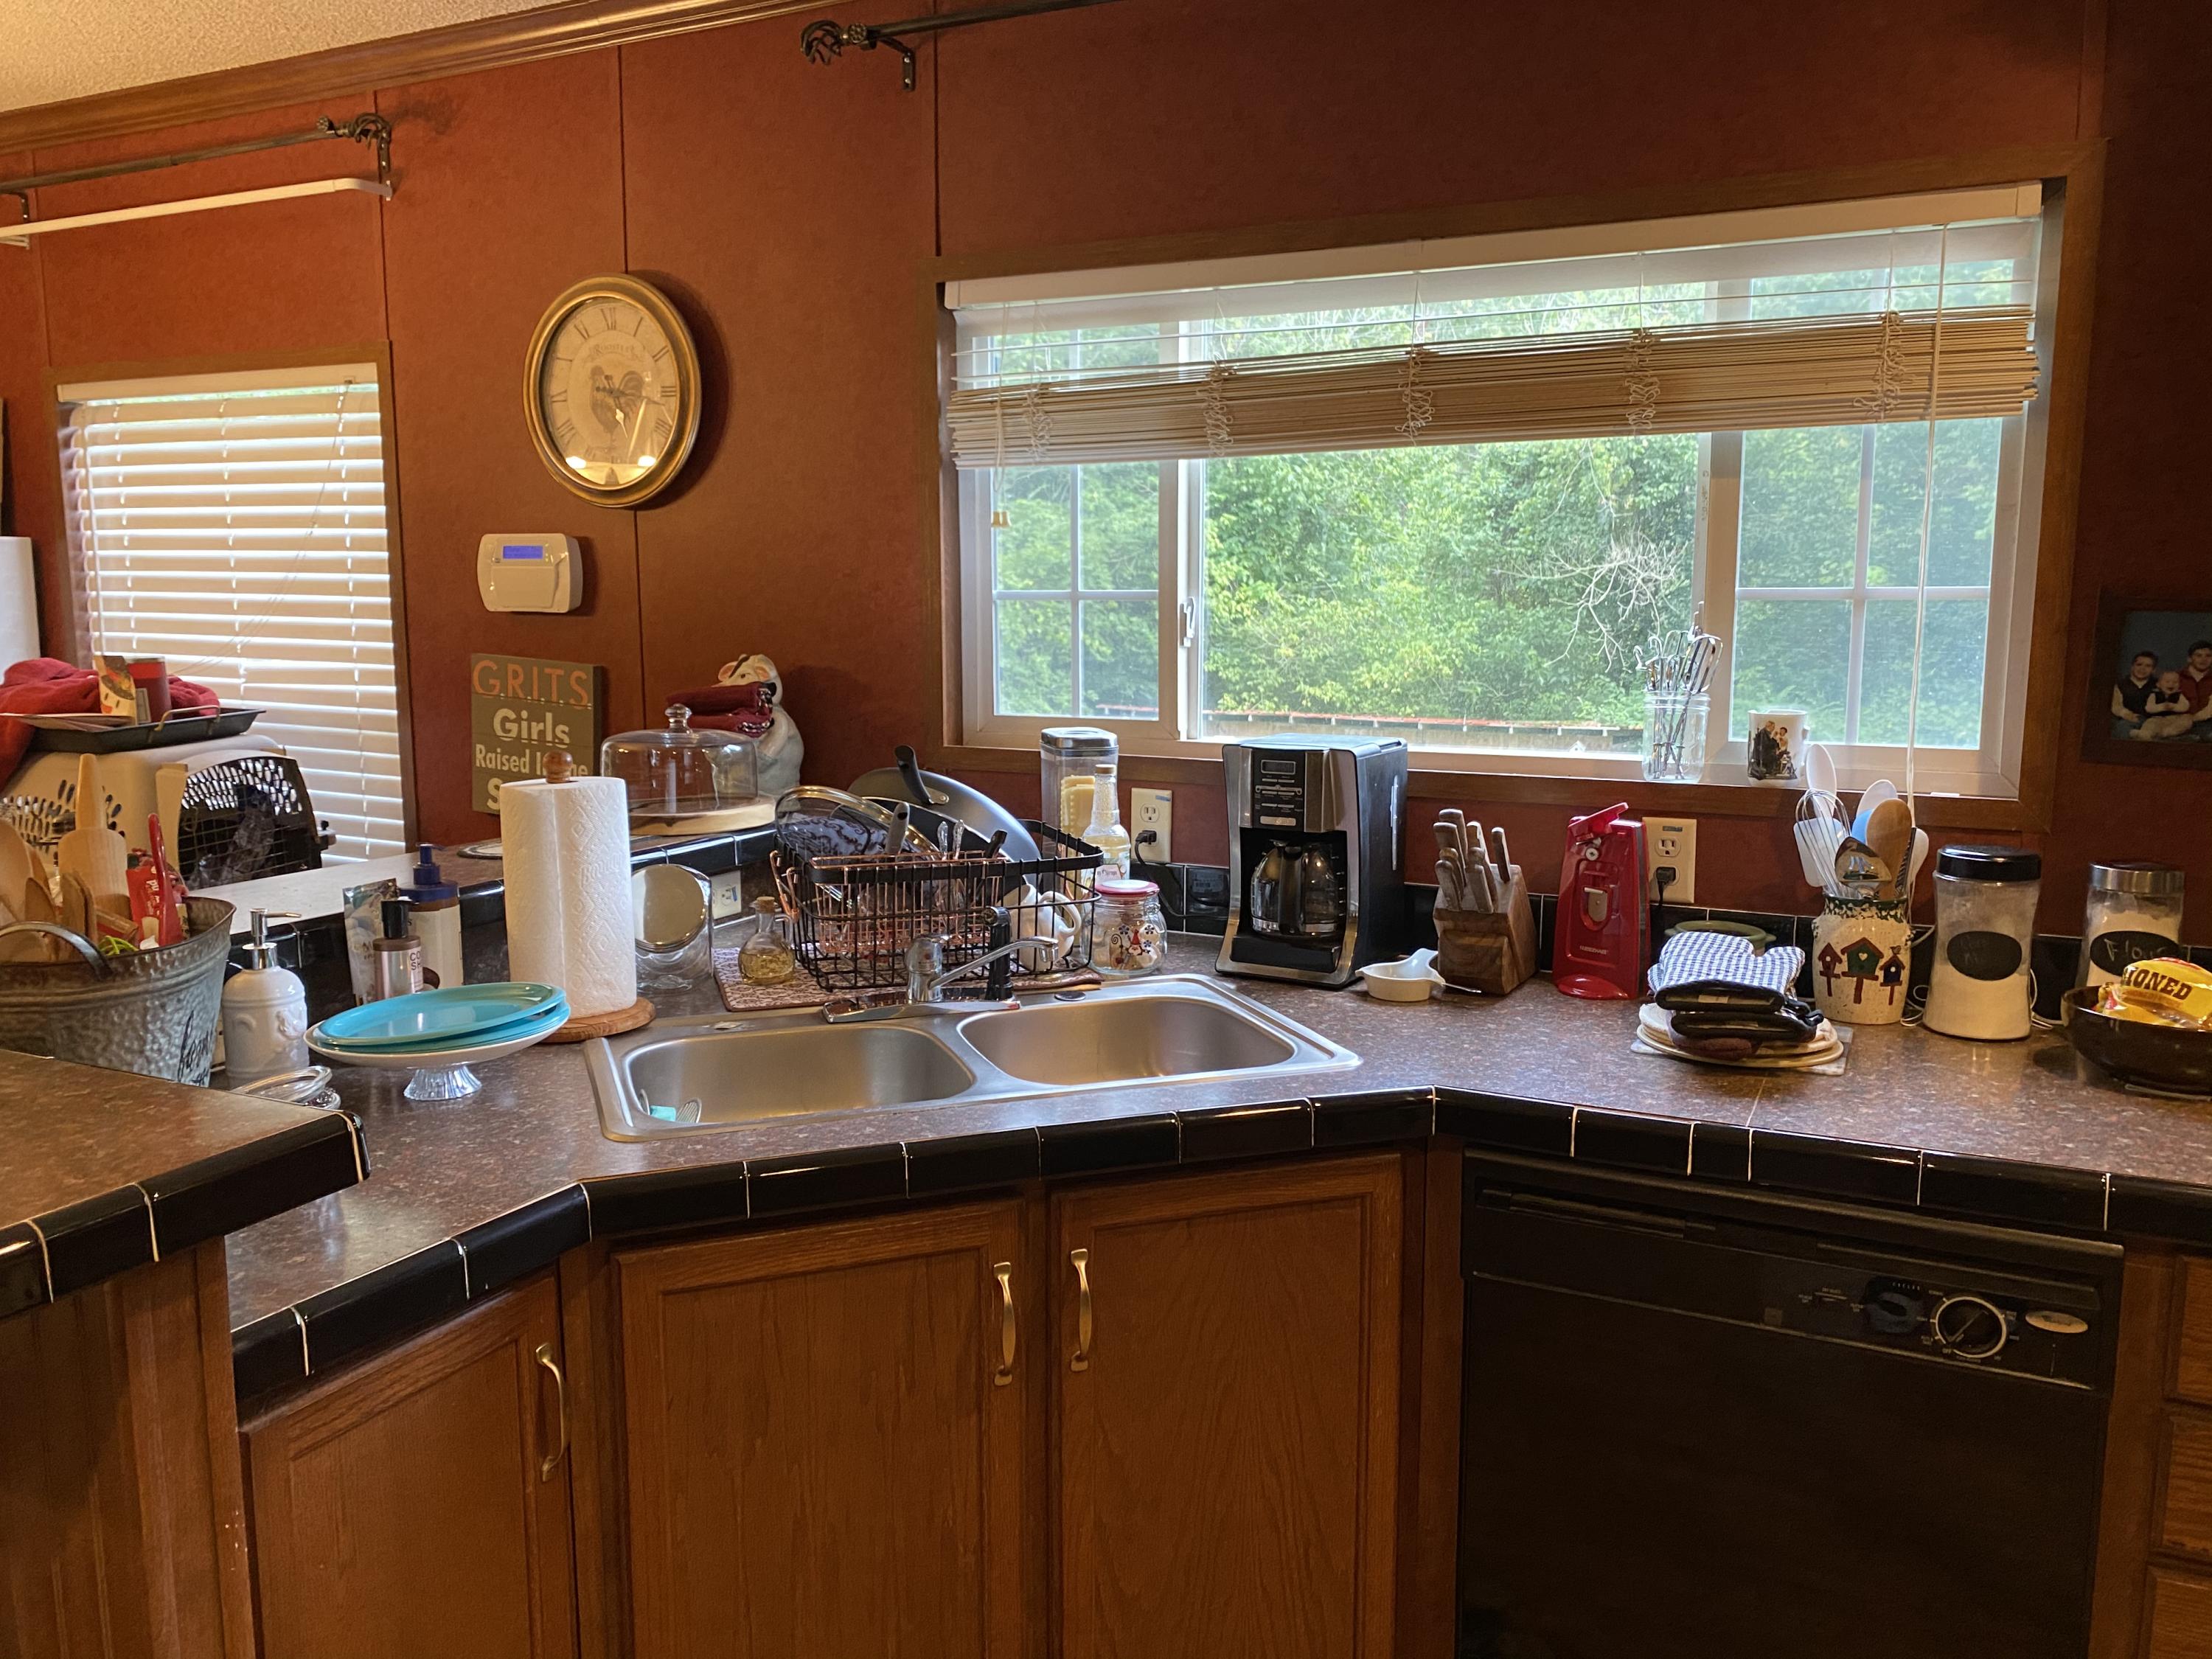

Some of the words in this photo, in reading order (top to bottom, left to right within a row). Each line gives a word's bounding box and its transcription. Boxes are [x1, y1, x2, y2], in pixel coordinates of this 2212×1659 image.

[493, 708, 571, 748] Girls
[476, 744, 529, 773] Raised
[536, 751, 546, 776] I
[2121, 965, 2193, 1001] IONED
